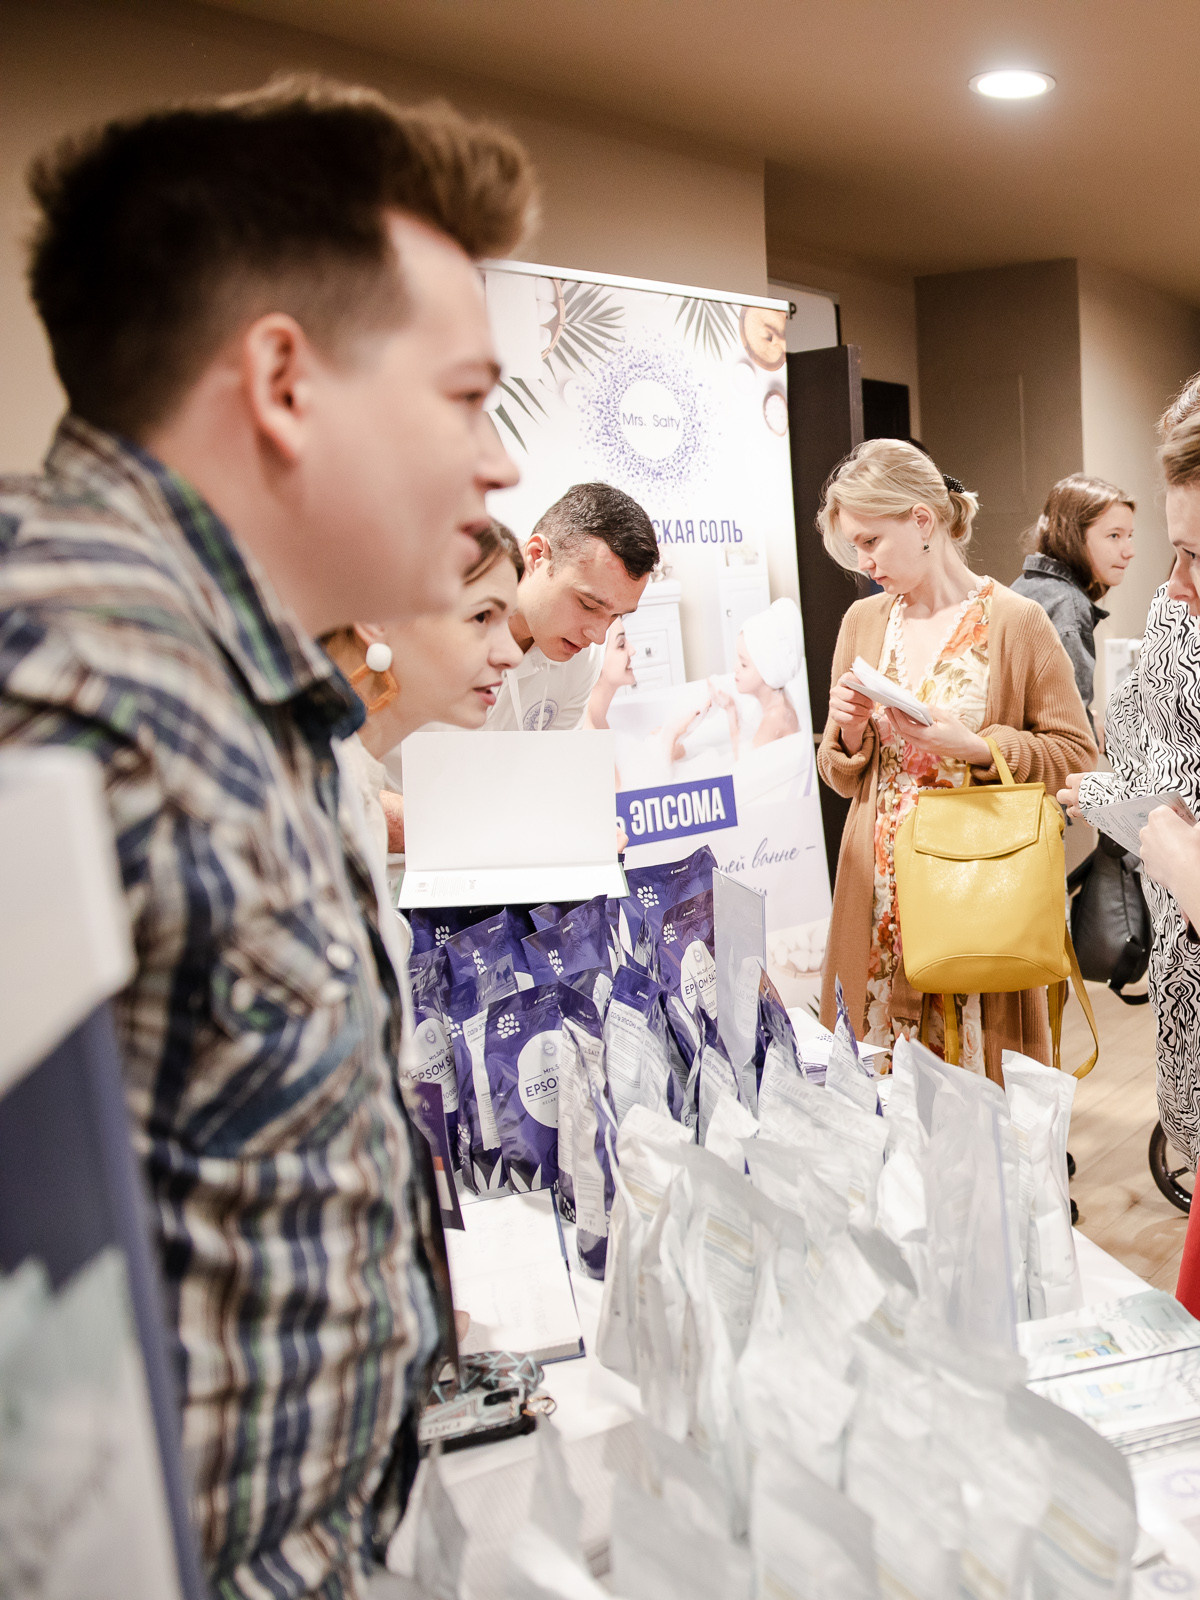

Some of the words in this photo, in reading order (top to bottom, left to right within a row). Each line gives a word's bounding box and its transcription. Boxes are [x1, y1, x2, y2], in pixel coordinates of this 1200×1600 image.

[622, 412, 646, 427] Mrs.
[652, 414, 681, 431] Salty
[699, 519, 743, 544] СОЛЬ
[629, 786, 726, 836] ЭПСОМА
